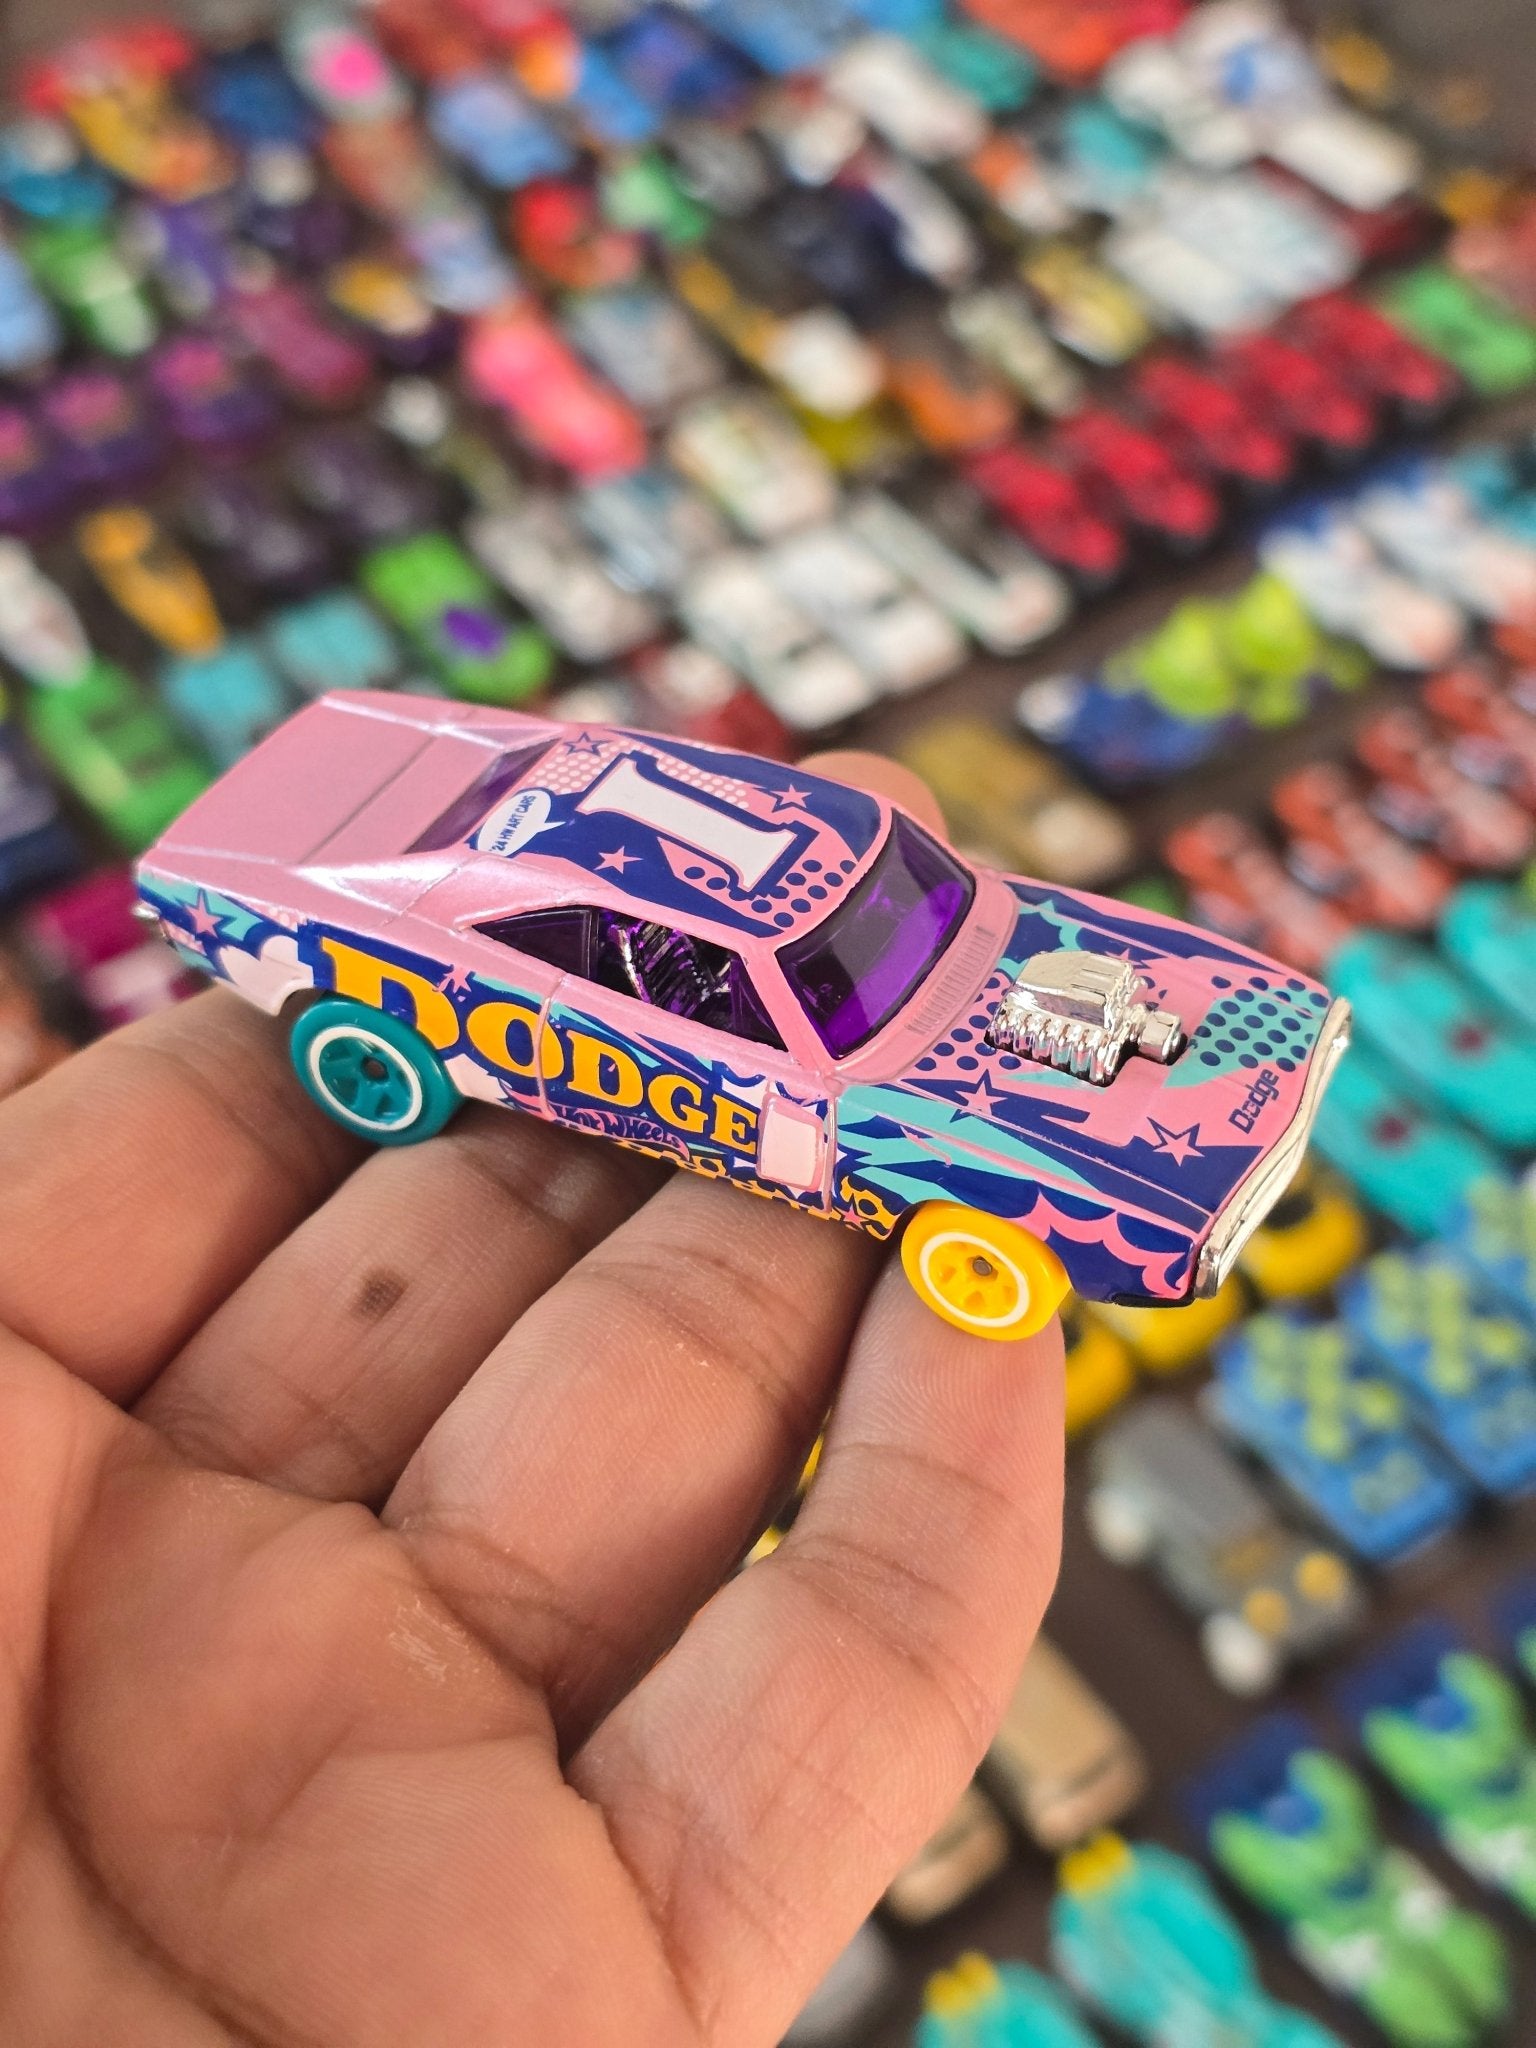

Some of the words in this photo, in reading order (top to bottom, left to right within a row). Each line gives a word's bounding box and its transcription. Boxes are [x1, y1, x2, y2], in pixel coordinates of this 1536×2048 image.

[506, 813, 525, 829] ART
[514, 795, 537, 814] CARS
[321, 937, 756, 1153] DODGE
[1228, 1068, 1280, 1135] Dodge
